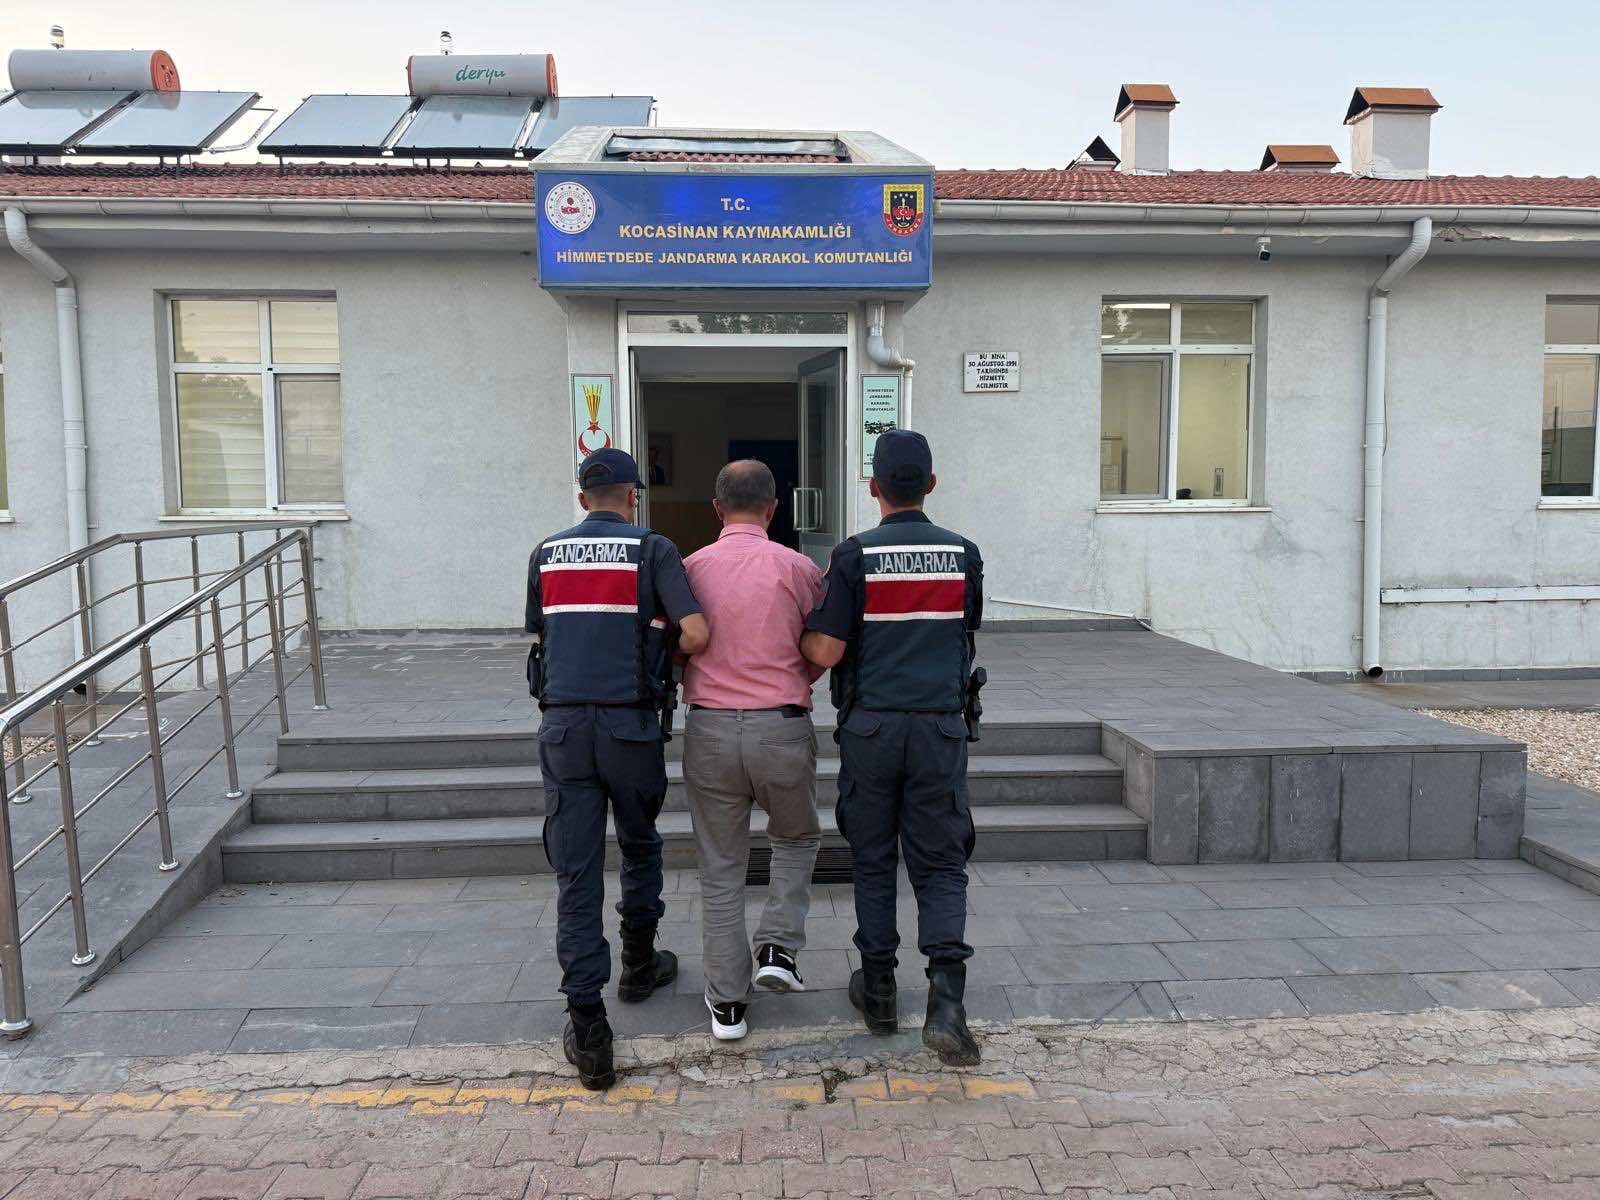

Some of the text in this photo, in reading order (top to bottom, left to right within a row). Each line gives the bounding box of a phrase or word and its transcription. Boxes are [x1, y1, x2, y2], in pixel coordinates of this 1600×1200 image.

[720, 197, 750, 211] T.C.
[619, 221, 851, 239] KOCASİNAN KAYMAKAMLIĞI
[556, 249, 912, 264] HİMMETDEDE JANDARMA KARAKOL KOMUTANLIĞI
[547, 543, 629, 564] JANDARMA
[875, 552, 959, 574] JANDARMA
